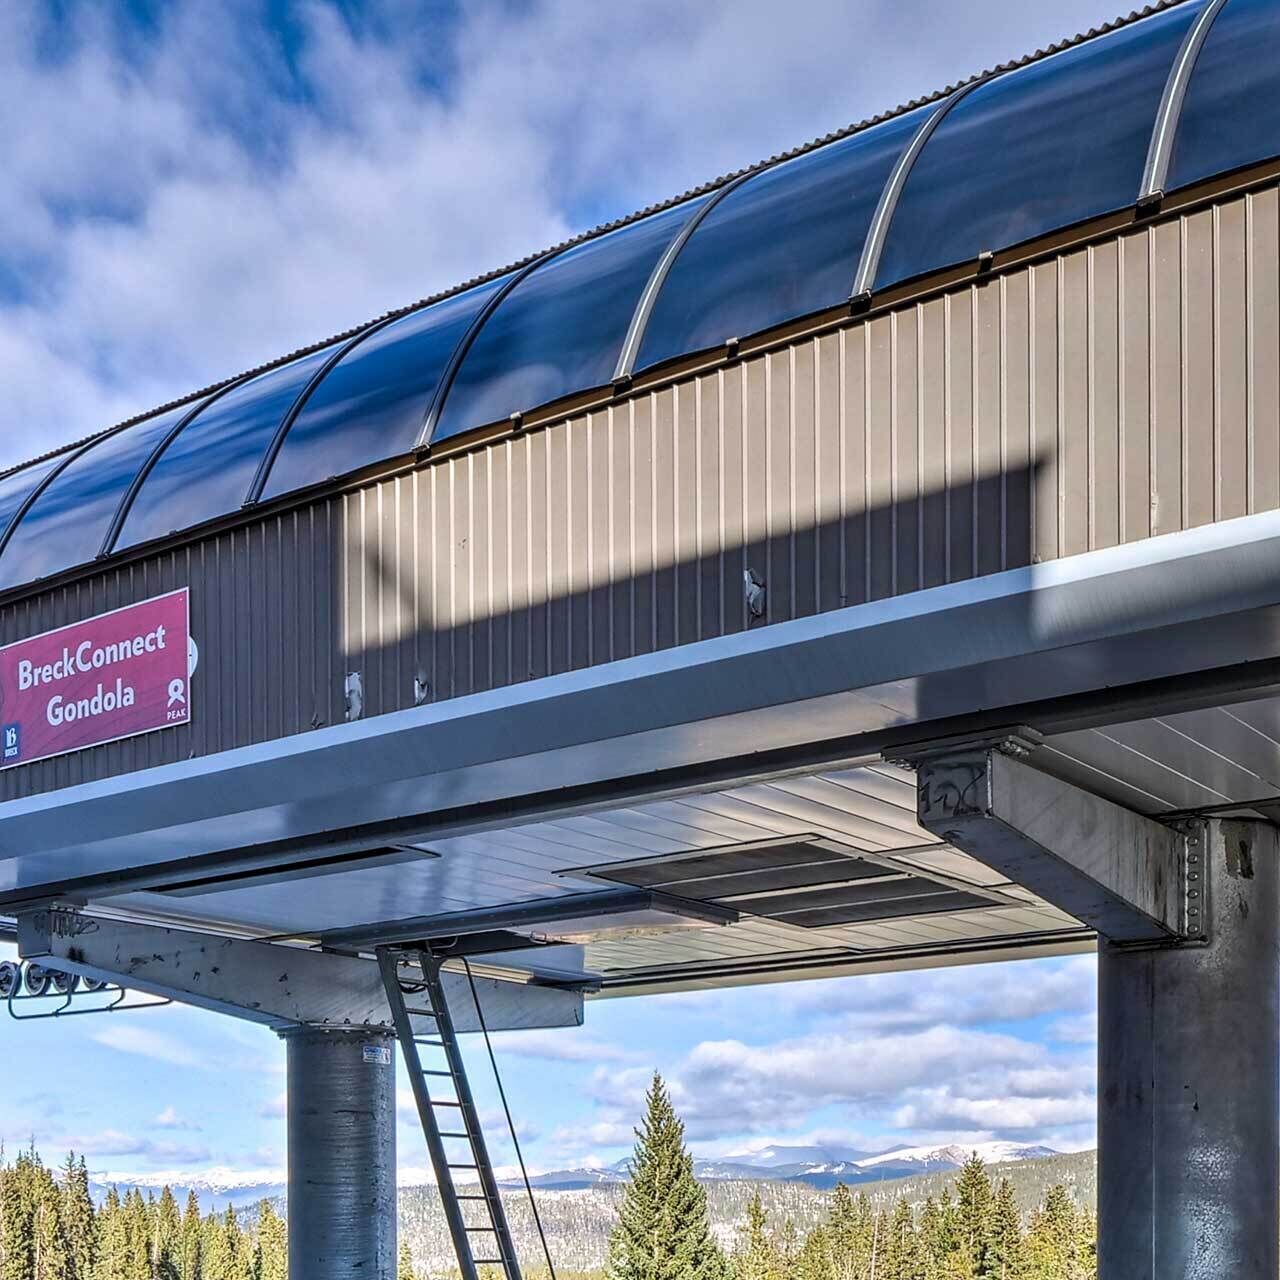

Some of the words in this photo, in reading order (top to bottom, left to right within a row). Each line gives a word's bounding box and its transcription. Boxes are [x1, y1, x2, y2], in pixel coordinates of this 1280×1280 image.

[18, 625, 166, 690] BreckConnect
[46, 678, 135, 726] Gondola
[167, 708, 186, 720] PEAK
